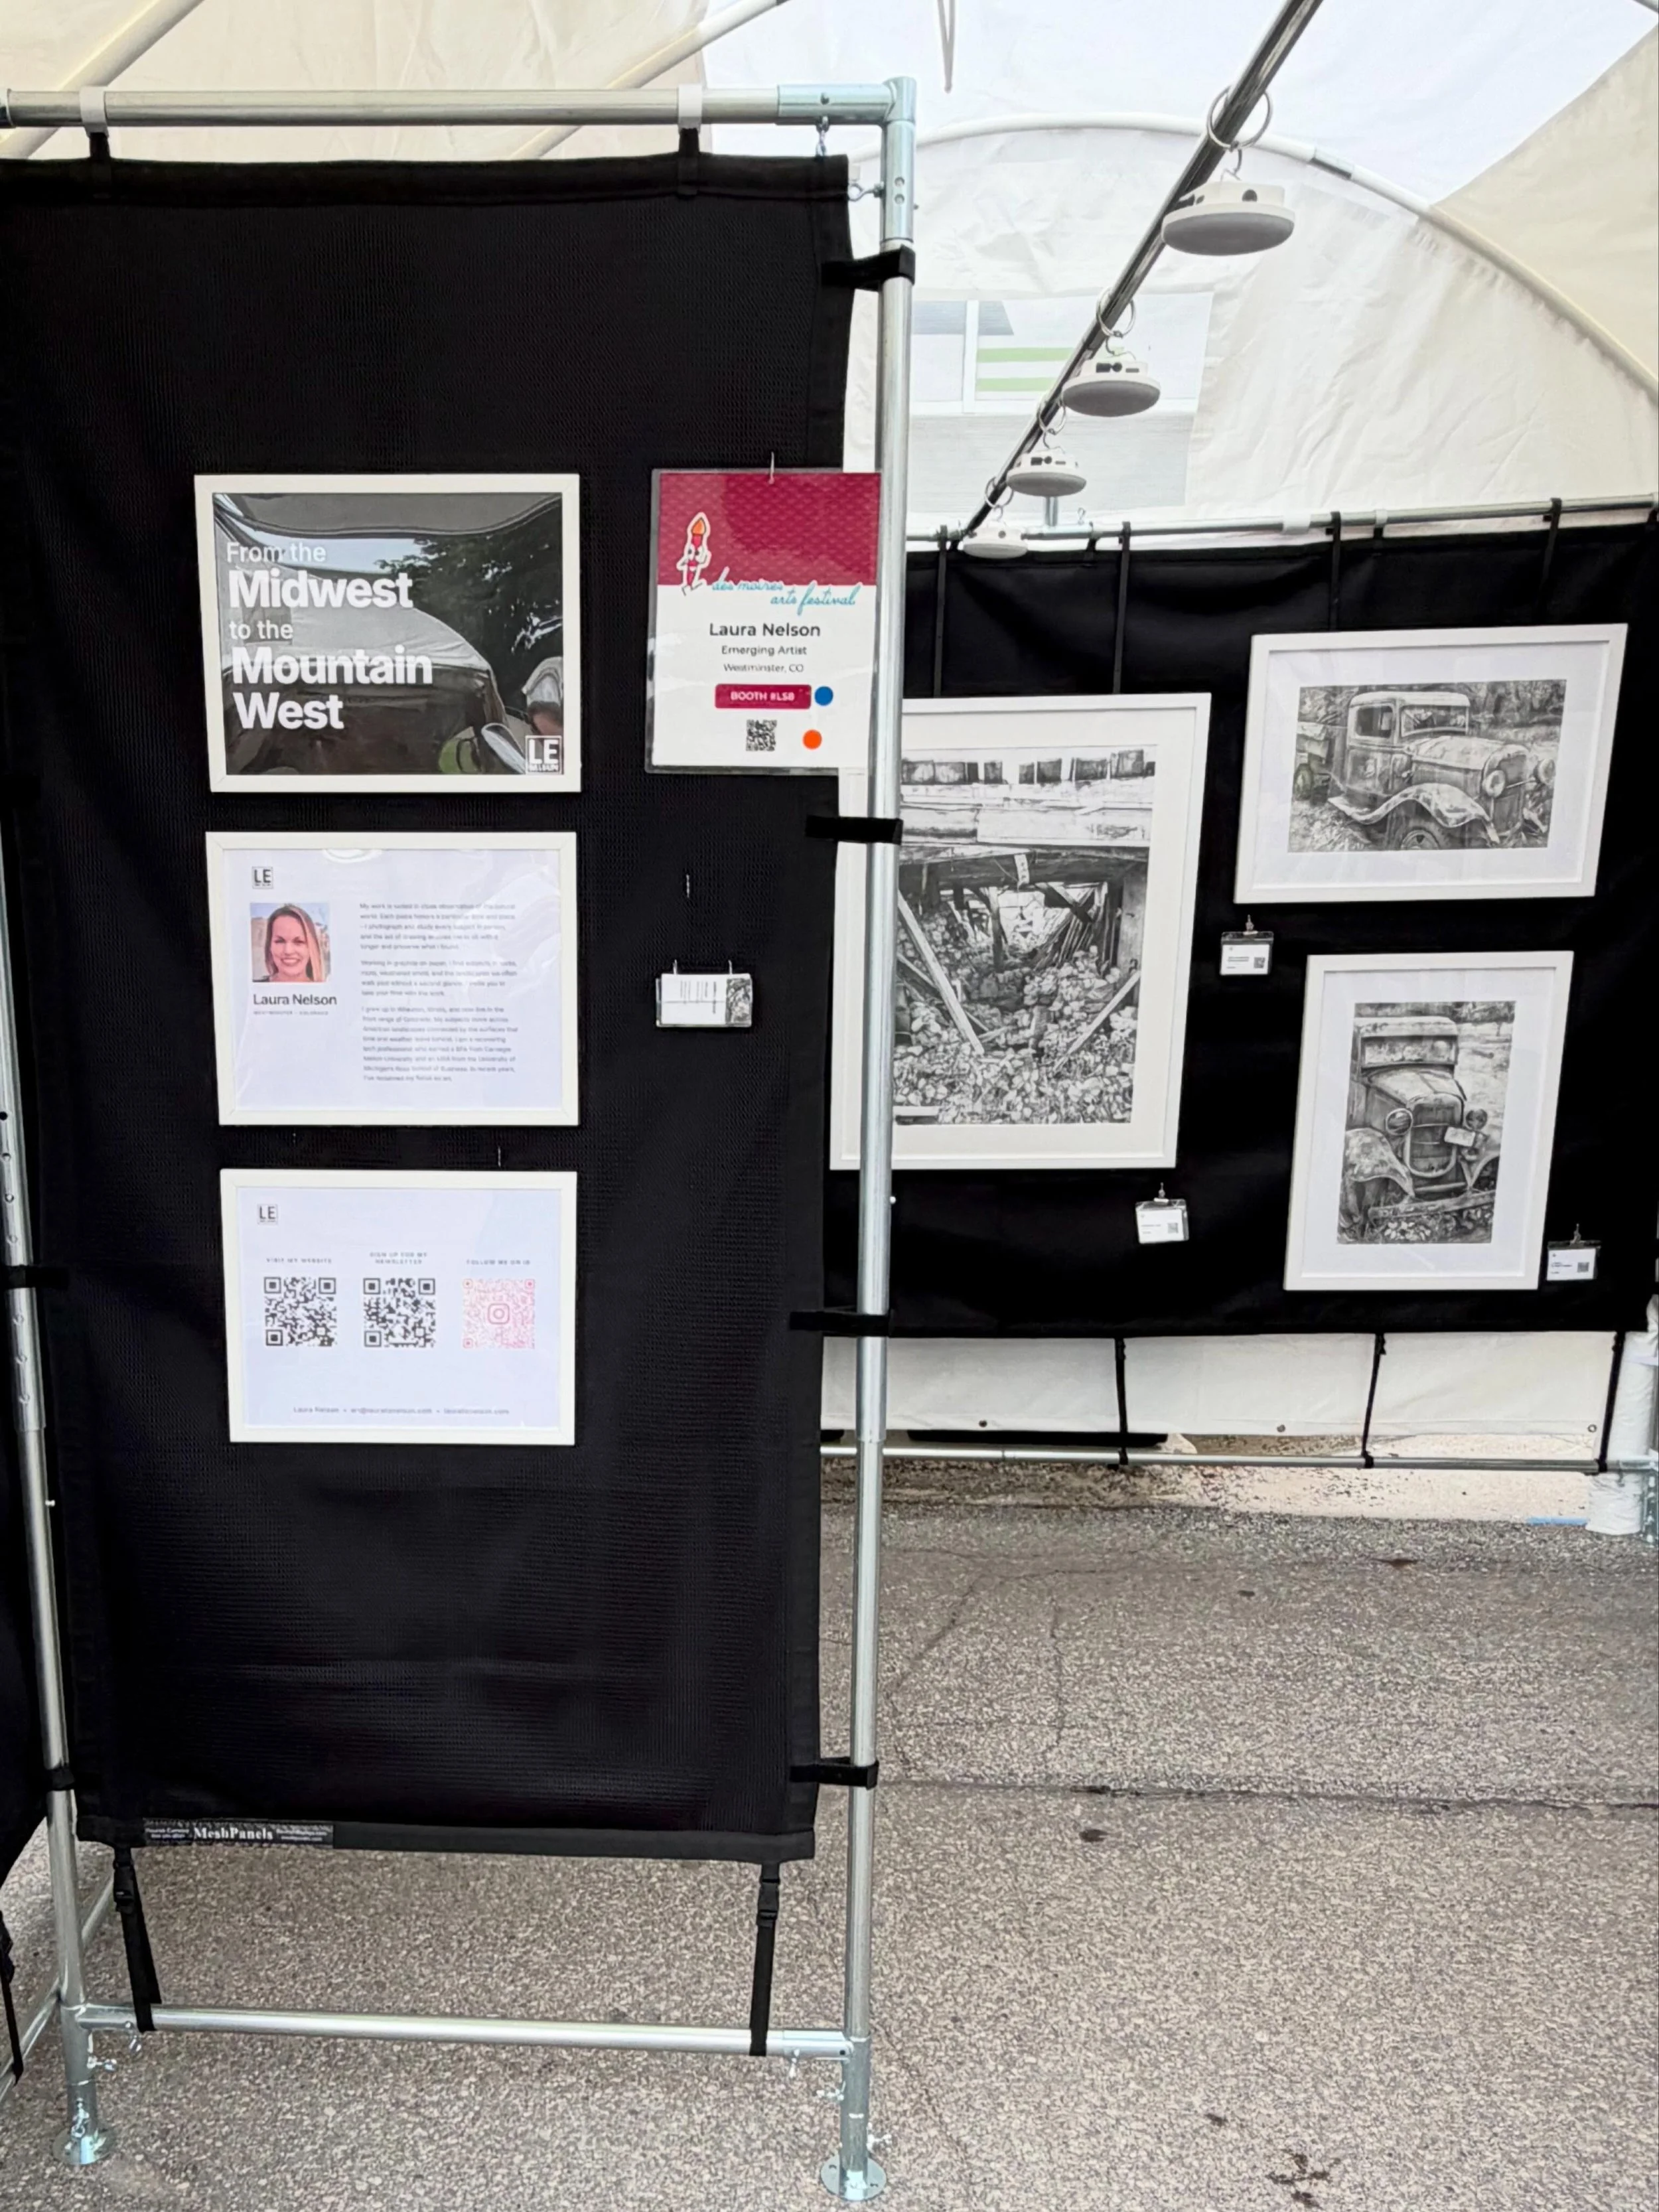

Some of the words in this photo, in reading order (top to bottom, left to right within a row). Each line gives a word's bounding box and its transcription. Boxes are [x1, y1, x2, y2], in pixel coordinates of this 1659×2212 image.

[226, 543, 285, 562] From
[289, 543, 326, 562] the
[712, 567, 733, 591] des
[228, 569, 414, 608] Midwest
[770, 589, 797, 605] arts
[797, 581, 861, 616] festival
[229, 622, 251, 640] to
[257, 620, 293, 640] the
[709, 623, 757, 636] Laura
[762, 623, 821, 637] Nelson
[721, 646, 775, 657] Emerging
[778, 646, 807, 656] Artist
[232, 645, 433, 685] Mountain
[788, 664, 804, 672] CO
[731, 691, 767, 701] BOOTH
[234, 692, 344, 729] West
[529, 739, 559, 764] LE
[253, 869, 271, 883] LE
[253, 994, 289, 1005] Laura
[293, 994, 337, 1005] Nelson
[259, 1206, 275, 1218] LE
[194, 1827, 273, 1840] MeshPanels
